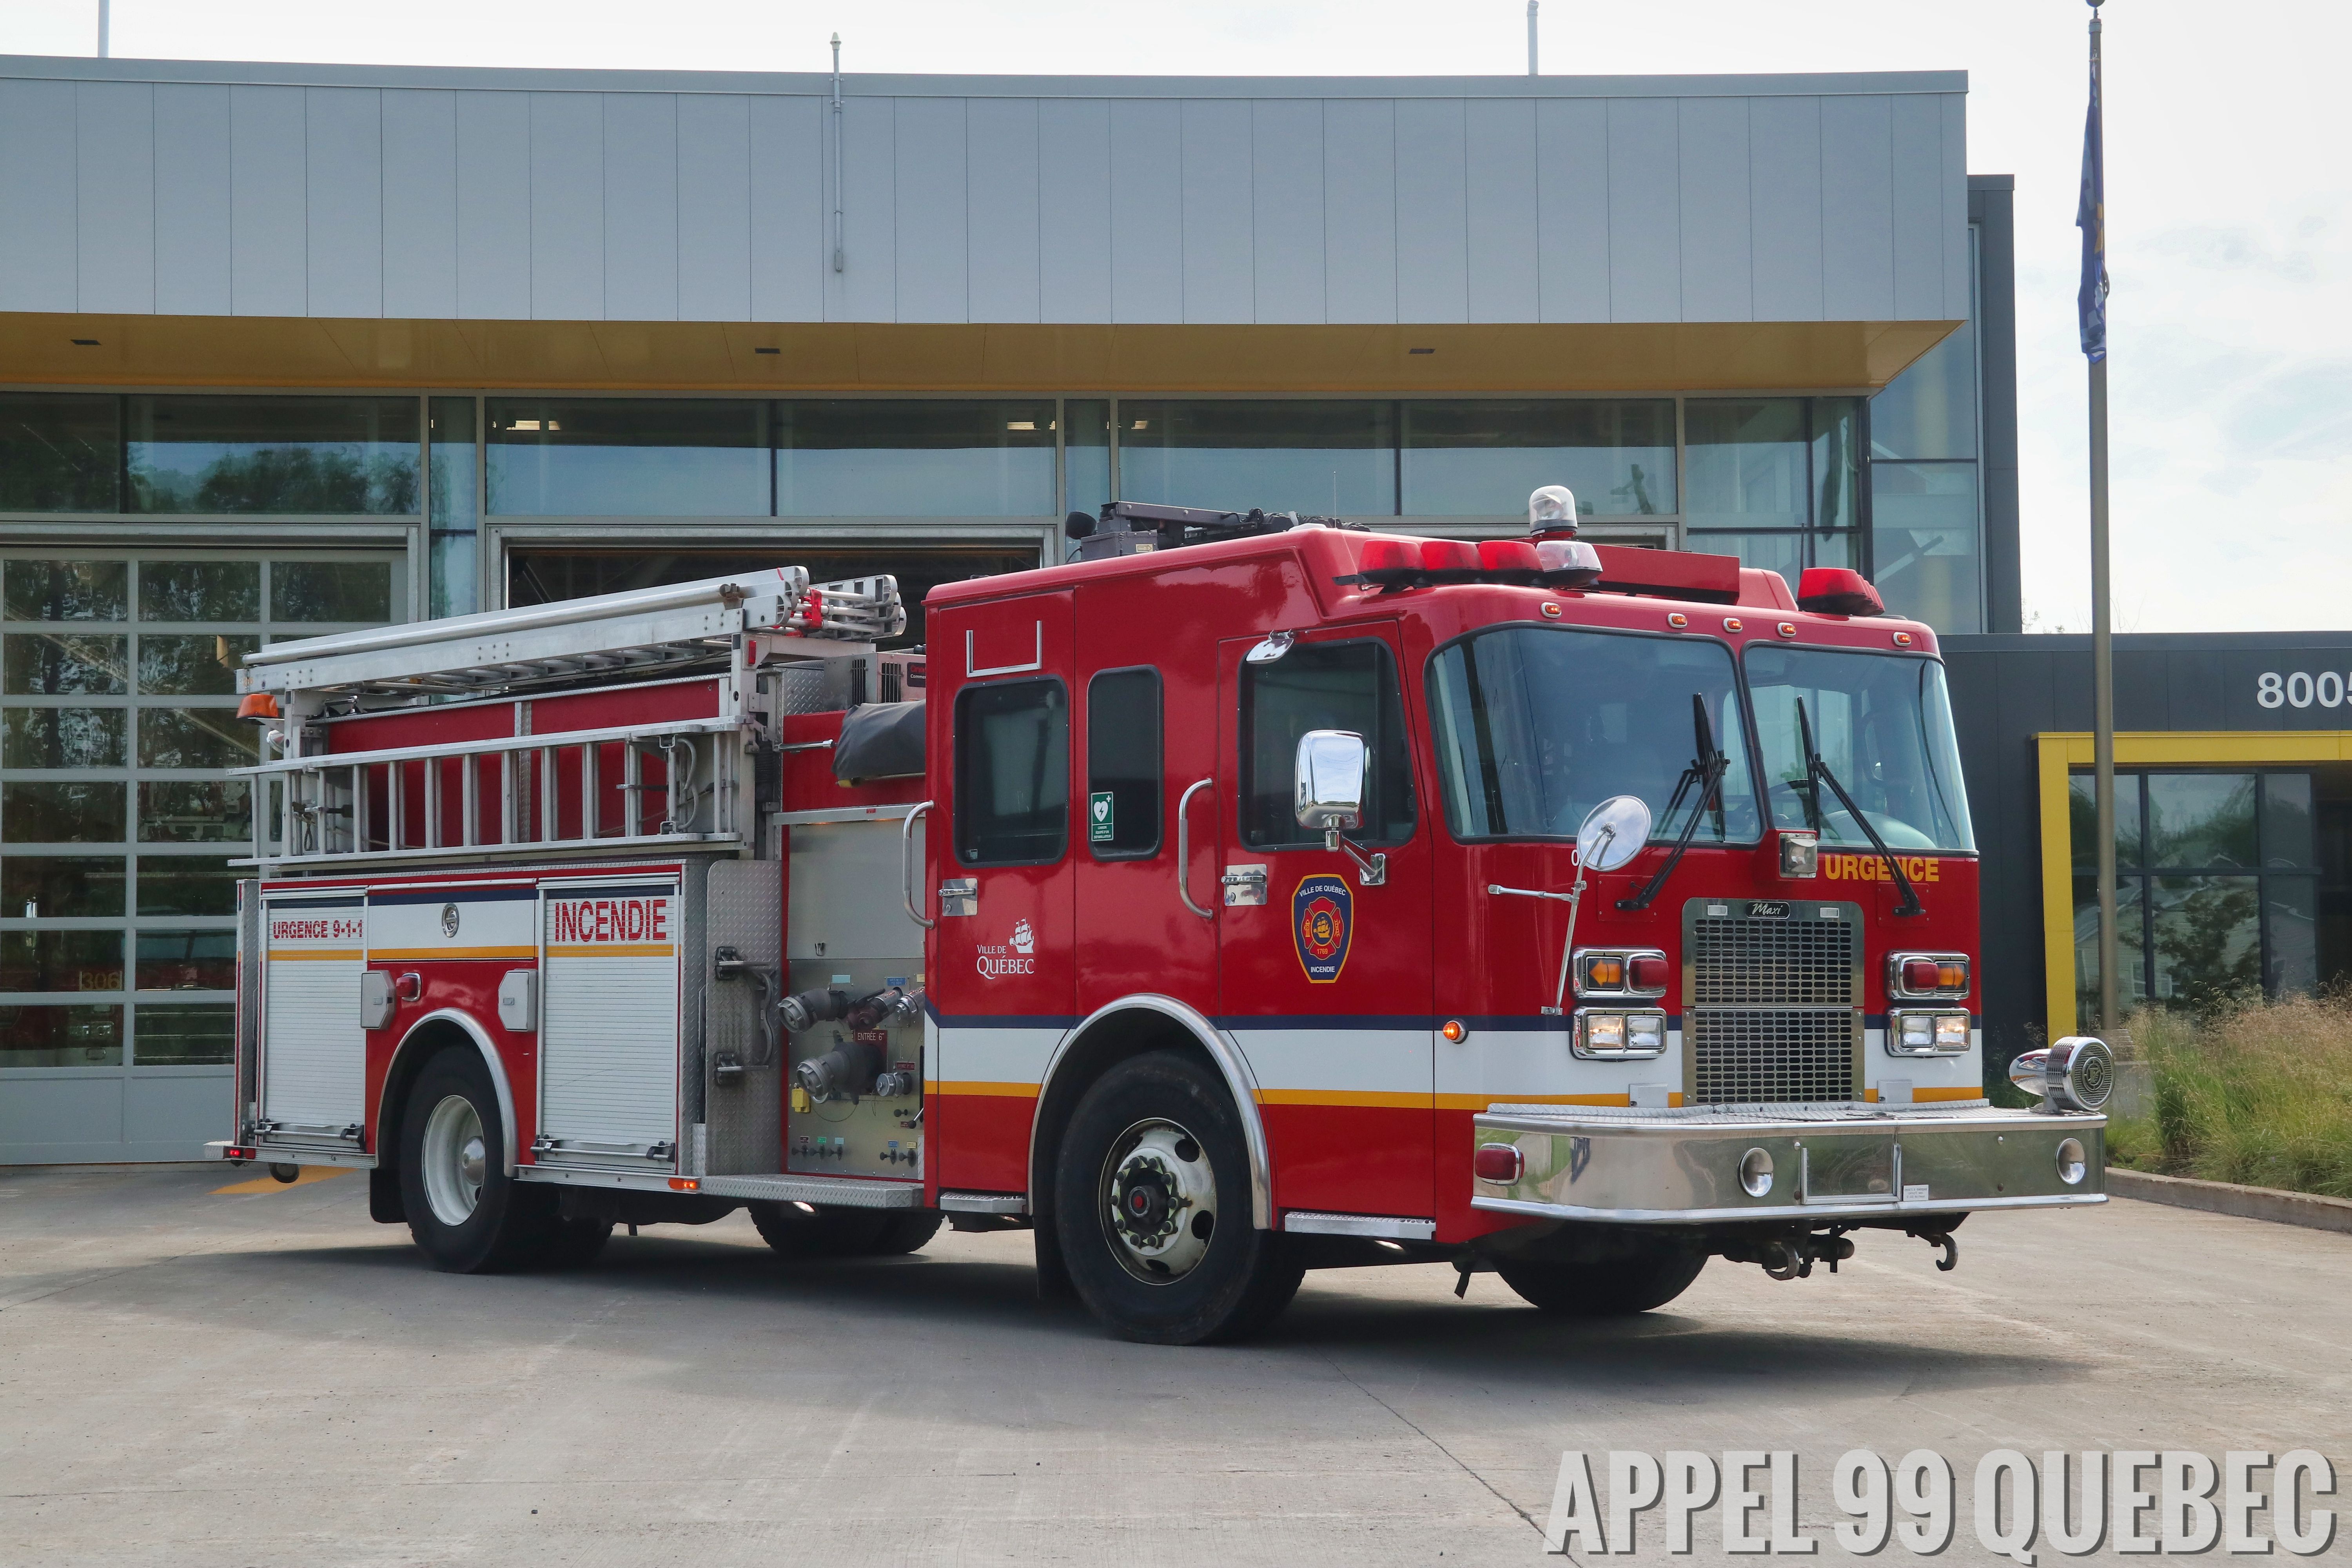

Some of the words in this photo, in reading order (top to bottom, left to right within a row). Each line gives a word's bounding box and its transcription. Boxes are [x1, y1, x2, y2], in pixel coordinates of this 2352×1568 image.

[2257, 671, 2352, 708] 800
[1299, 886, 1314, 897] VILLE
[1324, 885, 1347, 896] QUÉBEC
[1752, 903, 1783, 915] Maxi
[273, 920, 328, 939] URGENCE
[333, 920, 362, 938] 9-1-1
[555, 899, 666, 942] INCENDIE
[976, 955, 1034, 980] QUÉBEC
[857, 1031, 876, 1041] ENTRÉE
